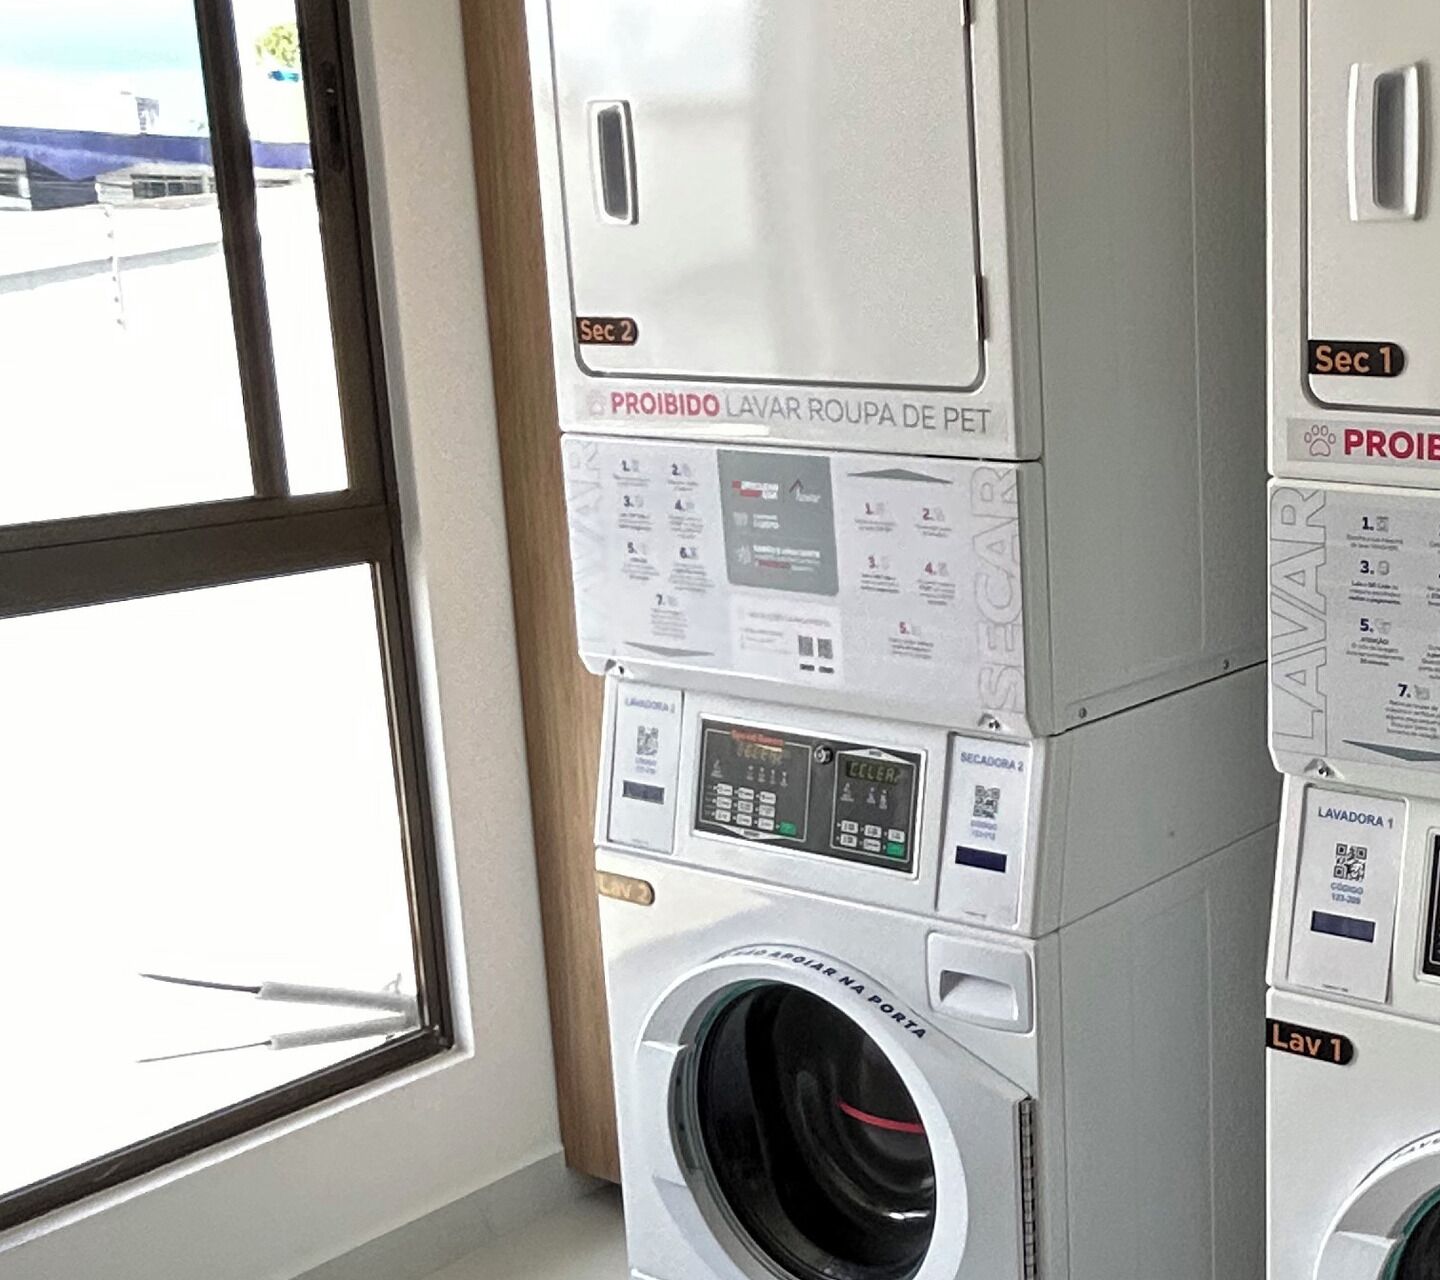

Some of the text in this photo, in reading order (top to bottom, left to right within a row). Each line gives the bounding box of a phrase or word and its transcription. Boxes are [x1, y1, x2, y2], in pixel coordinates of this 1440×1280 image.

[580, 319, 634, 341] Sec 2
[1315, 345, 1391, 374] Sec 1
[610, 391, 991, 434] PROIBIDO LAVAR ROUPA DE PET
[1362, 516, 1375, 531] 1.
[1360, 560, 1375, 575] 3.
[1270, 486, 1328, 757] LAVAR
[1360, 617, 1374, 633] 5.
[1397, 682, 1412, 699] 7.
[960, 751, 1025, 772] SECADORA 2
[1317, 806, 1394, 830] LAVADORA 1
[770, 950, 838, 977] APOIAR
[838, 976, 866, 995] NA
[867, 994, 927, 1039] PORTA
[1272, 1023, 1341, 1062] Lav 1
